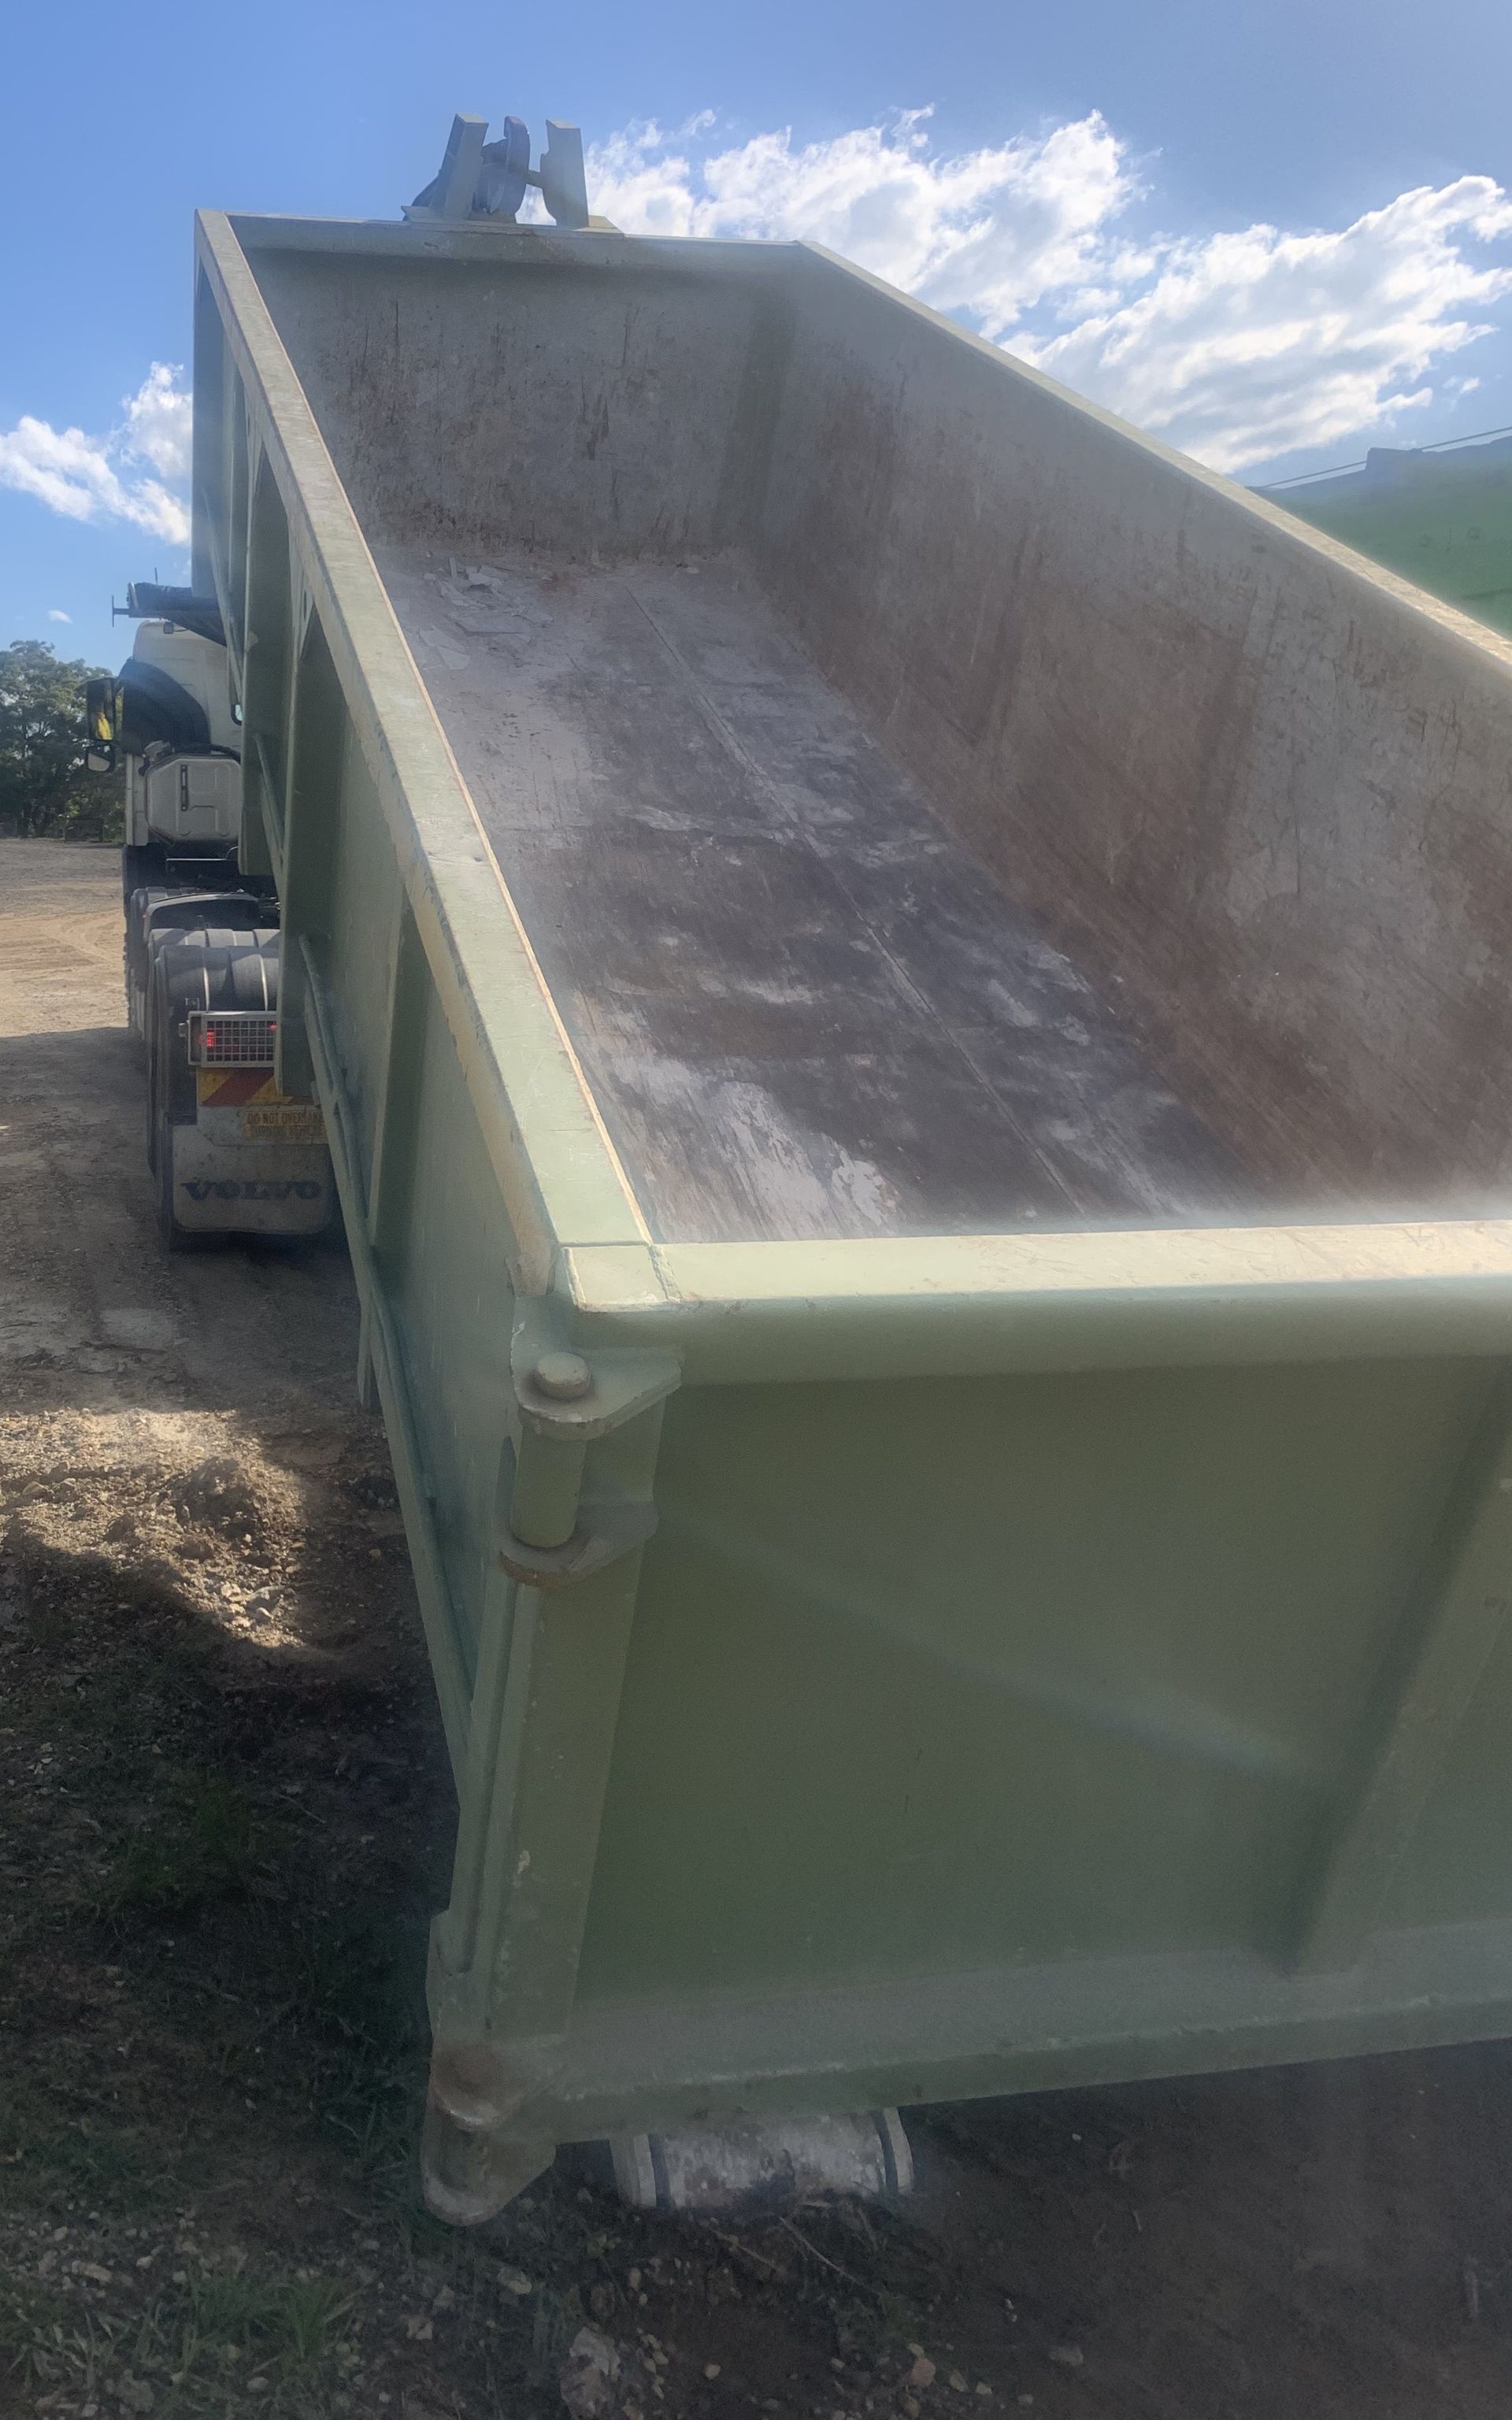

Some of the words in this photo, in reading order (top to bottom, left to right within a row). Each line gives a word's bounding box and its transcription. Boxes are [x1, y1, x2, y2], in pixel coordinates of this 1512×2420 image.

[247, 1112, 261, 1125] DO
[262, 1112, 279, 1125] NOT
[181, 1180, 321, 1201] VOLVO
